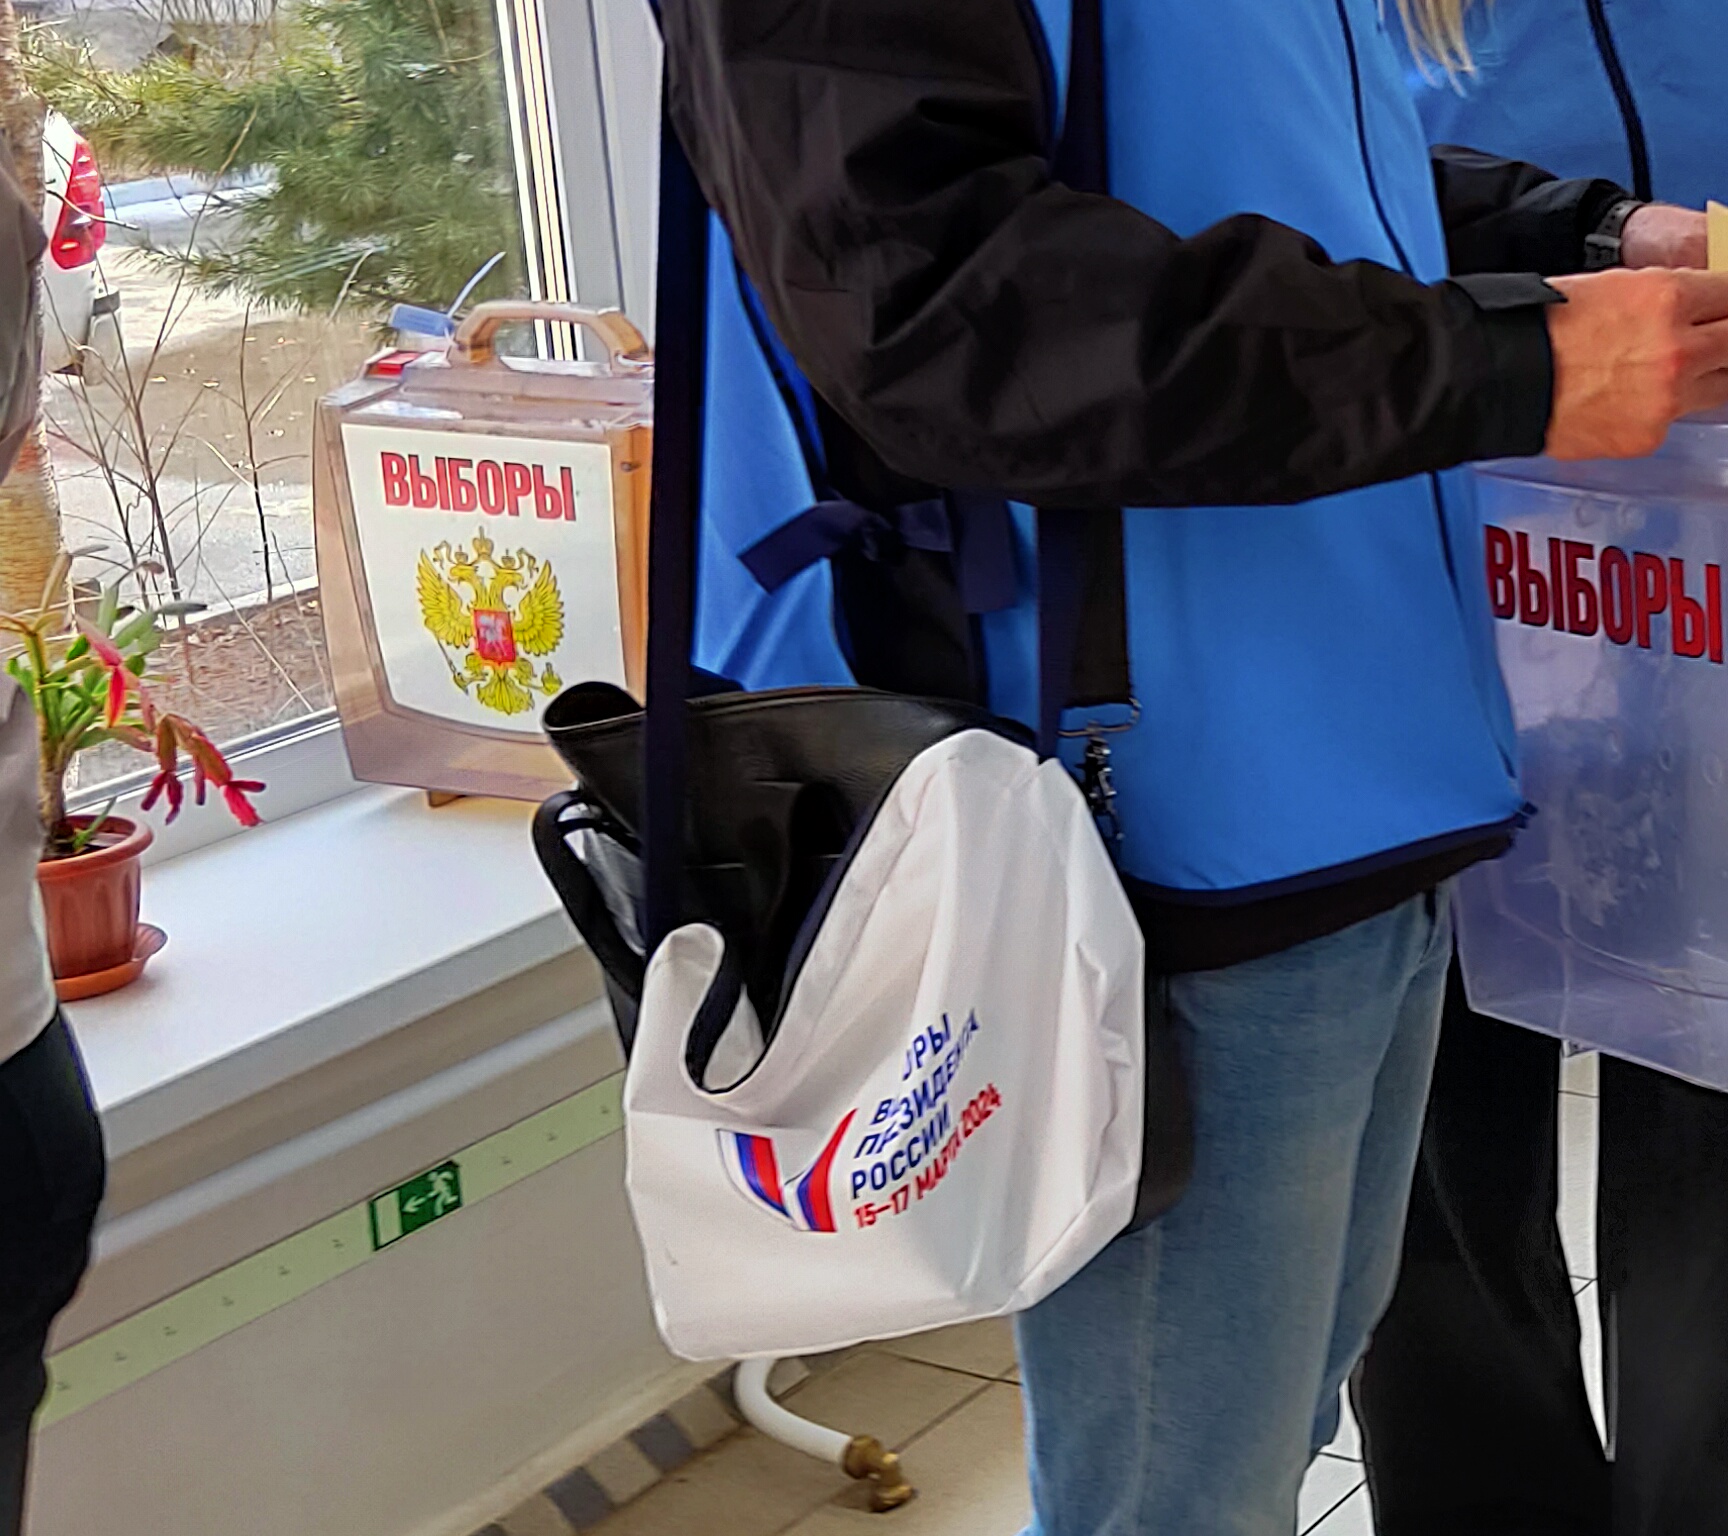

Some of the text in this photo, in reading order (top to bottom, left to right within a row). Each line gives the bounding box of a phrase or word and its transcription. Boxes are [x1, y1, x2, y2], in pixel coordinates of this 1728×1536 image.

[380, 451, 577, 522] ВЫБОРЫ
[1483, 523, 1724, 665] ВЫБОРЫ
[851, 1102, 950, 1199] РОССИИ
[961, 1082, 1002, 1139] 2024
